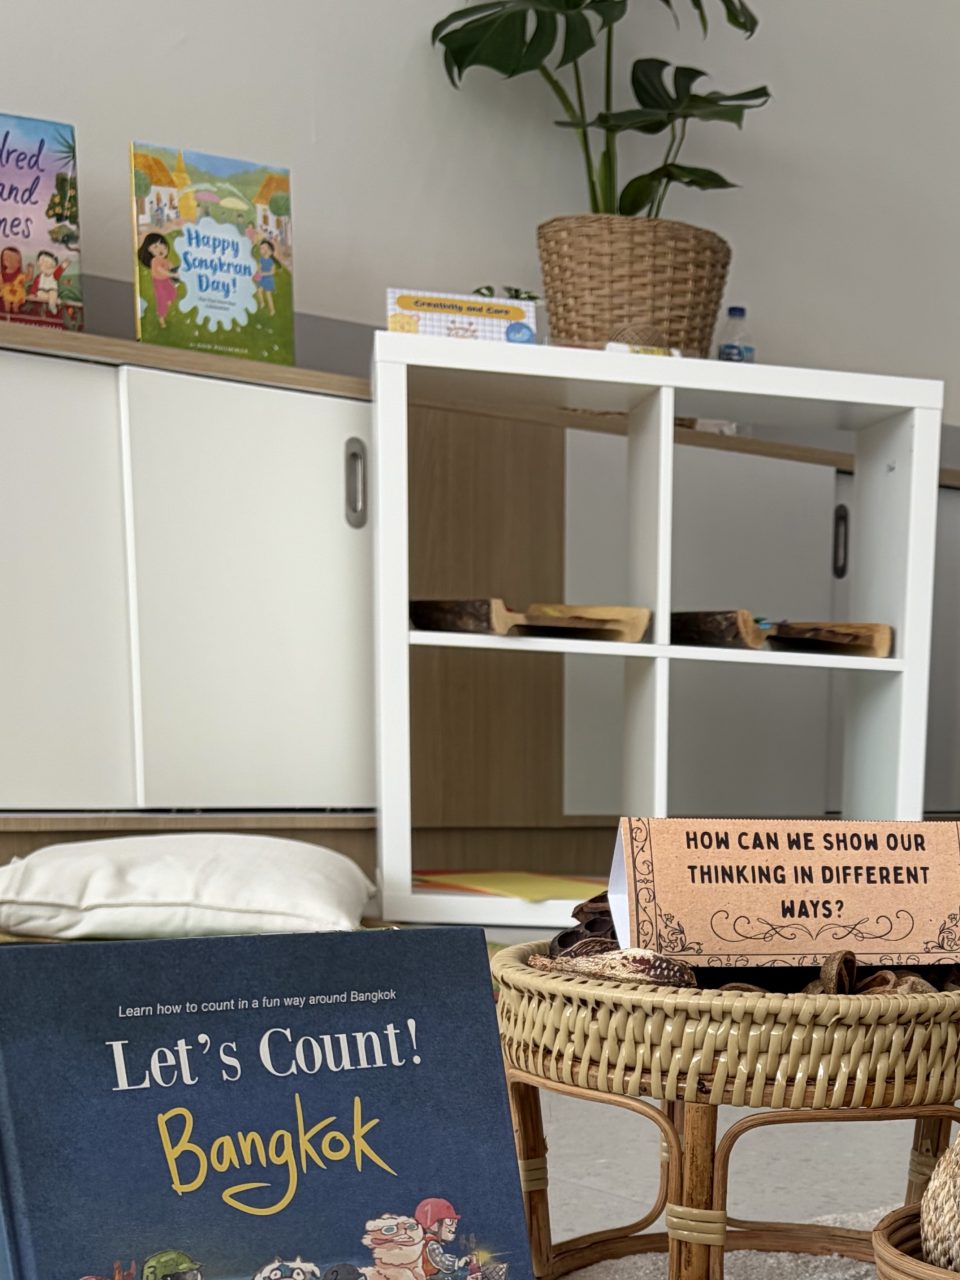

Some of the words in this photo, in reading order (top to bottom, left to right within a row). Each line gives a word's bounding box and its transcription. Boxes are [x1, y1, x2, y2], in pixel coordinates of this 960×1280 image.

[186, 227, 240, 258] Happy
[182, 250, 252, 277] Songkran
[197, 273, 237, 299] Day!
[414, 300, 464, 313] Creativity
[466, 305, 483, 313] and
[685, 831, 730, 850] HOW
[738, 831, 780, 850] CAN
[787, 832, 815, 850] WE
[823, 832, 878, 851] SHOW
[886, 833, 926, 852] OUR
[687, 865, 786, 884] THINKING
[794, 866, 814, 884] IN
[821, 866, 930, 885] DIFFERENT
[781, 899, 844, 919] WAYS?
[118, 1005, 153, 1018] Learn
[156, 1003, 182, 1014] how
[186, 1001, 198, 1013] to
[201, 998, 235, 1012] count
[238, 997, 249, 1009] in
[251, 999, 259, 1008] a
[262, 996, 280, 1008] fun
[283, 996, 306, 1008] way
[308, 991, 348, 1005] around
[350, 988, 397, 1004] Bangkok
[105, 1032, 243, 1092] Let's
[258, 1017, 422, 1078] Count!
[156, 1092, 399, 1217] Bangkok
[424, 1203, 433, 1227] 1
